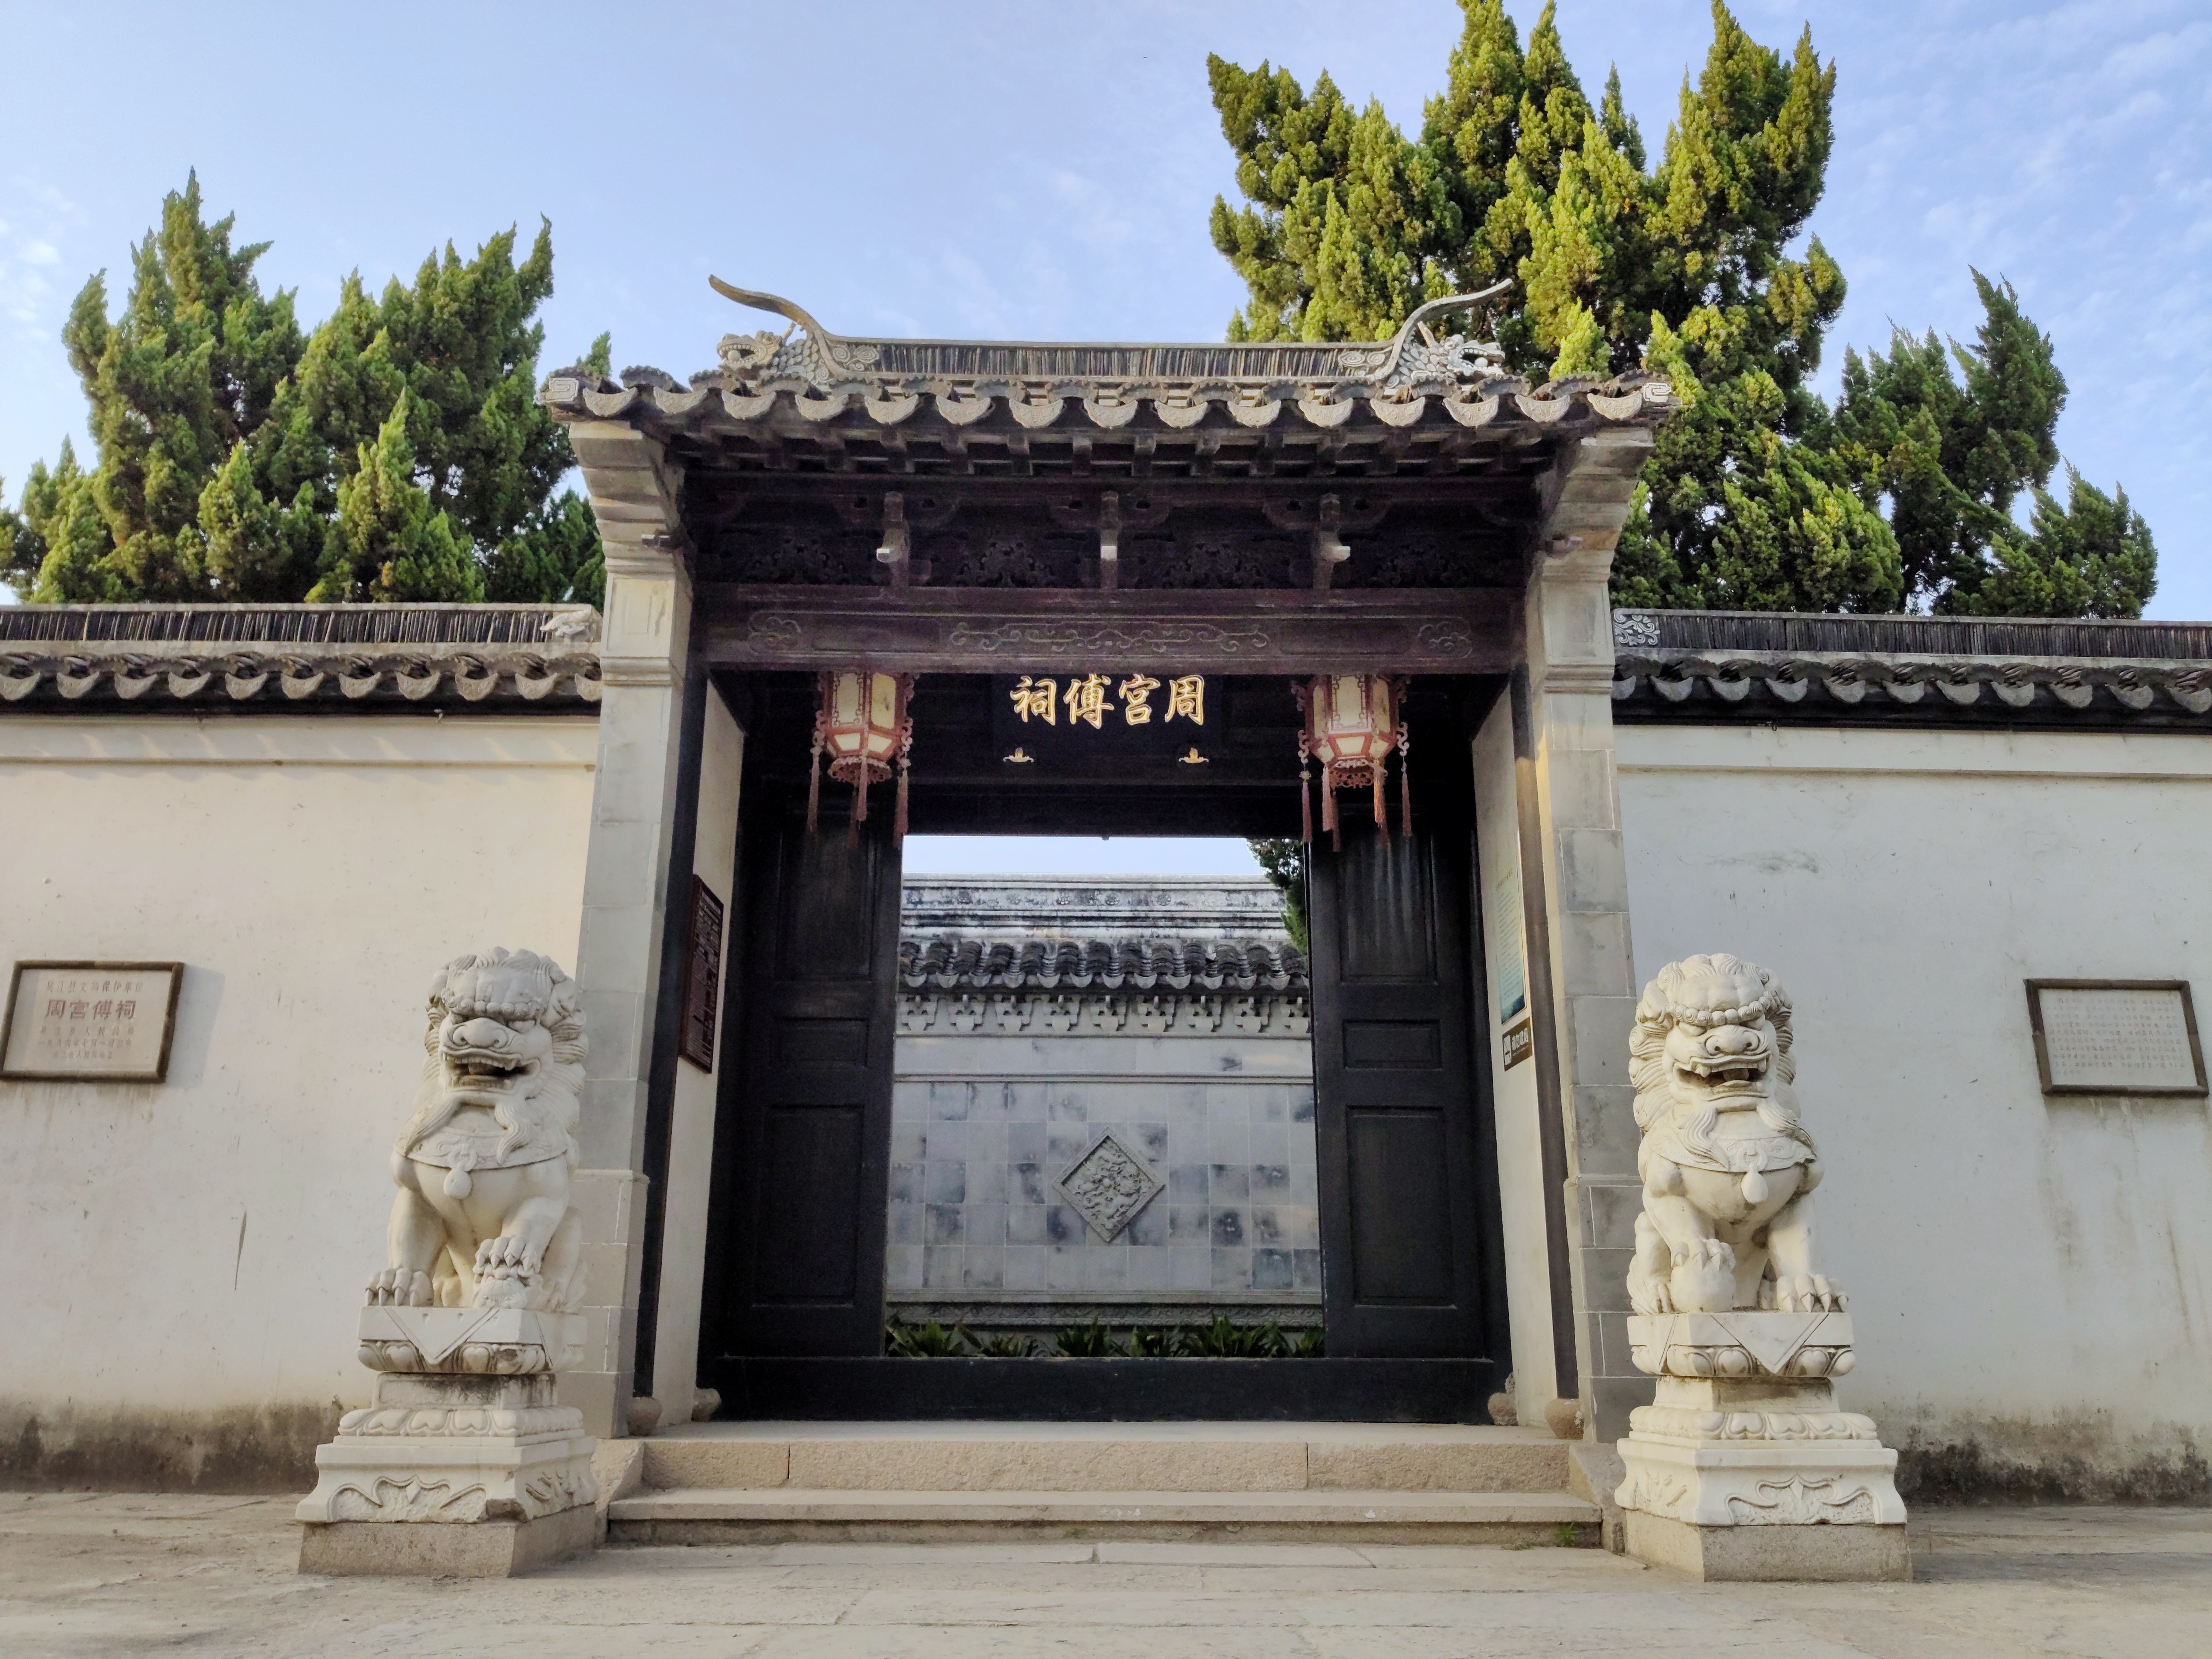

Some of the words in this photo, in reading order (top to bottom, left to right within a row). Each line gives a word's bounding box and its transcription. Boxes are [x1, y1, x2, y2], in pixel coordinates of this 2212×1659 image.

[45, 999, 136, 1020] 周宫傅祠
[1512, 1028, 1528, 1051] 请勿吸烟
